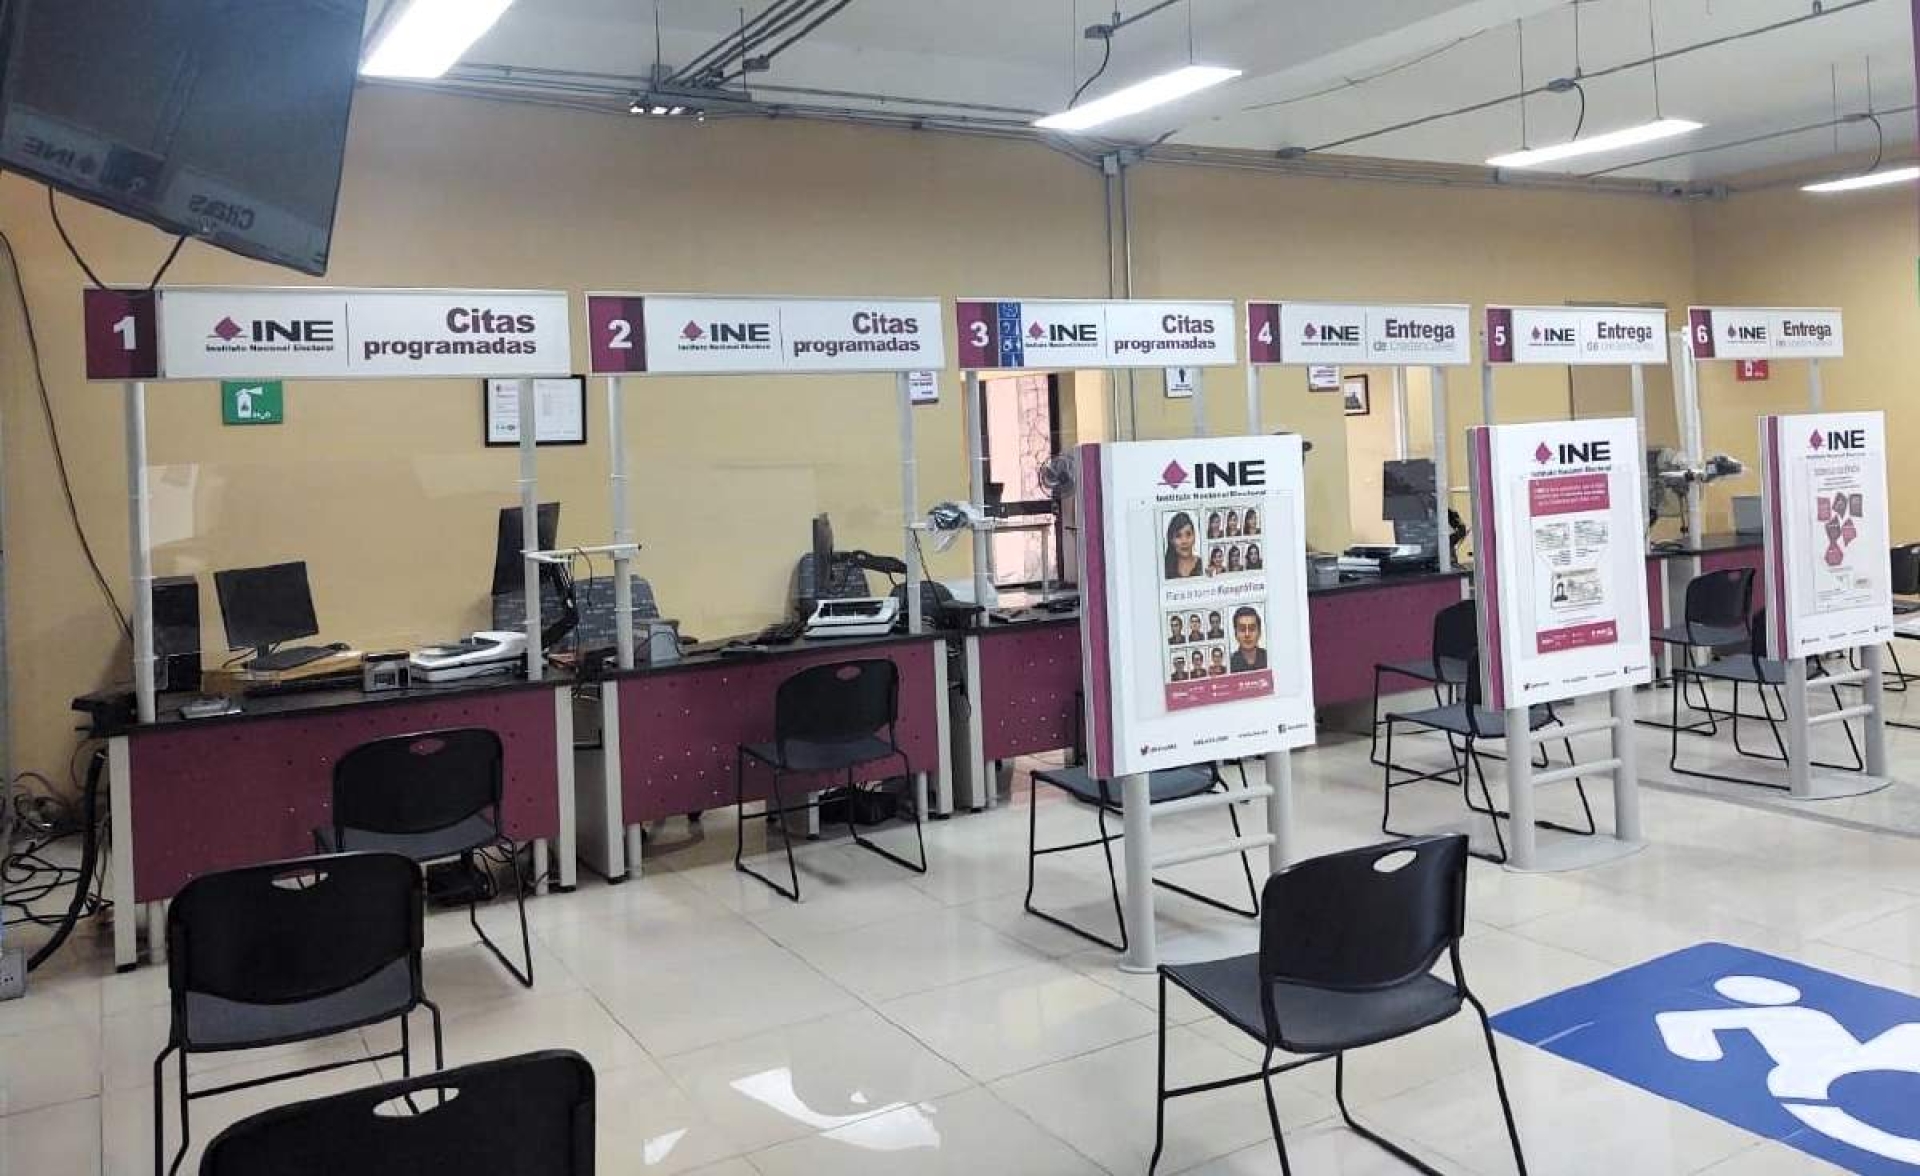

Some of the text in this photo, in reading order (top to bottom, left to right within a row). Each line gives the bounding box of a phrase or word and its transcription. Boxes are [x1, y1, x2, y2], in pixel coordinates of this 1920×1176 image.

[252, 320, 334, 341] INE
[447, 307, 536, 333] Citas
[852, 311, 919, 335] Citas
[1162, 314, 1215, 334] Citas
[1385, 319, 1456, 342] Entrega
[1783, 320, 1832, 340] Entrega
[113, 316, 137, 350] 1
[608, 319, 633, 349] 2
[710, 323, 771, 342] INE
[970, 321, 989, 347] 3
[1049, 324, 1097, 341] INE
[1257, 321, 1273, 344] 4
[1321, 325, 1360, 341] INE
[1494, 325, 1507, 346] 5
[1544, 327, 1576, 342] INE
[1597, 322, 1652, 342] Entrega
[1697, 325, 1708, 344] 6
[1738, 326, 1766, 340] INE
[364, 337, 537, 360] programadas
[793, 337, 921, 358] programadas
[1114, 336, 1216, 354] programadas
[1827, 430, 1865, 451] INE
[1559, 441, 1611, 465] INE
[1194, 460, 1265, 489] INE
